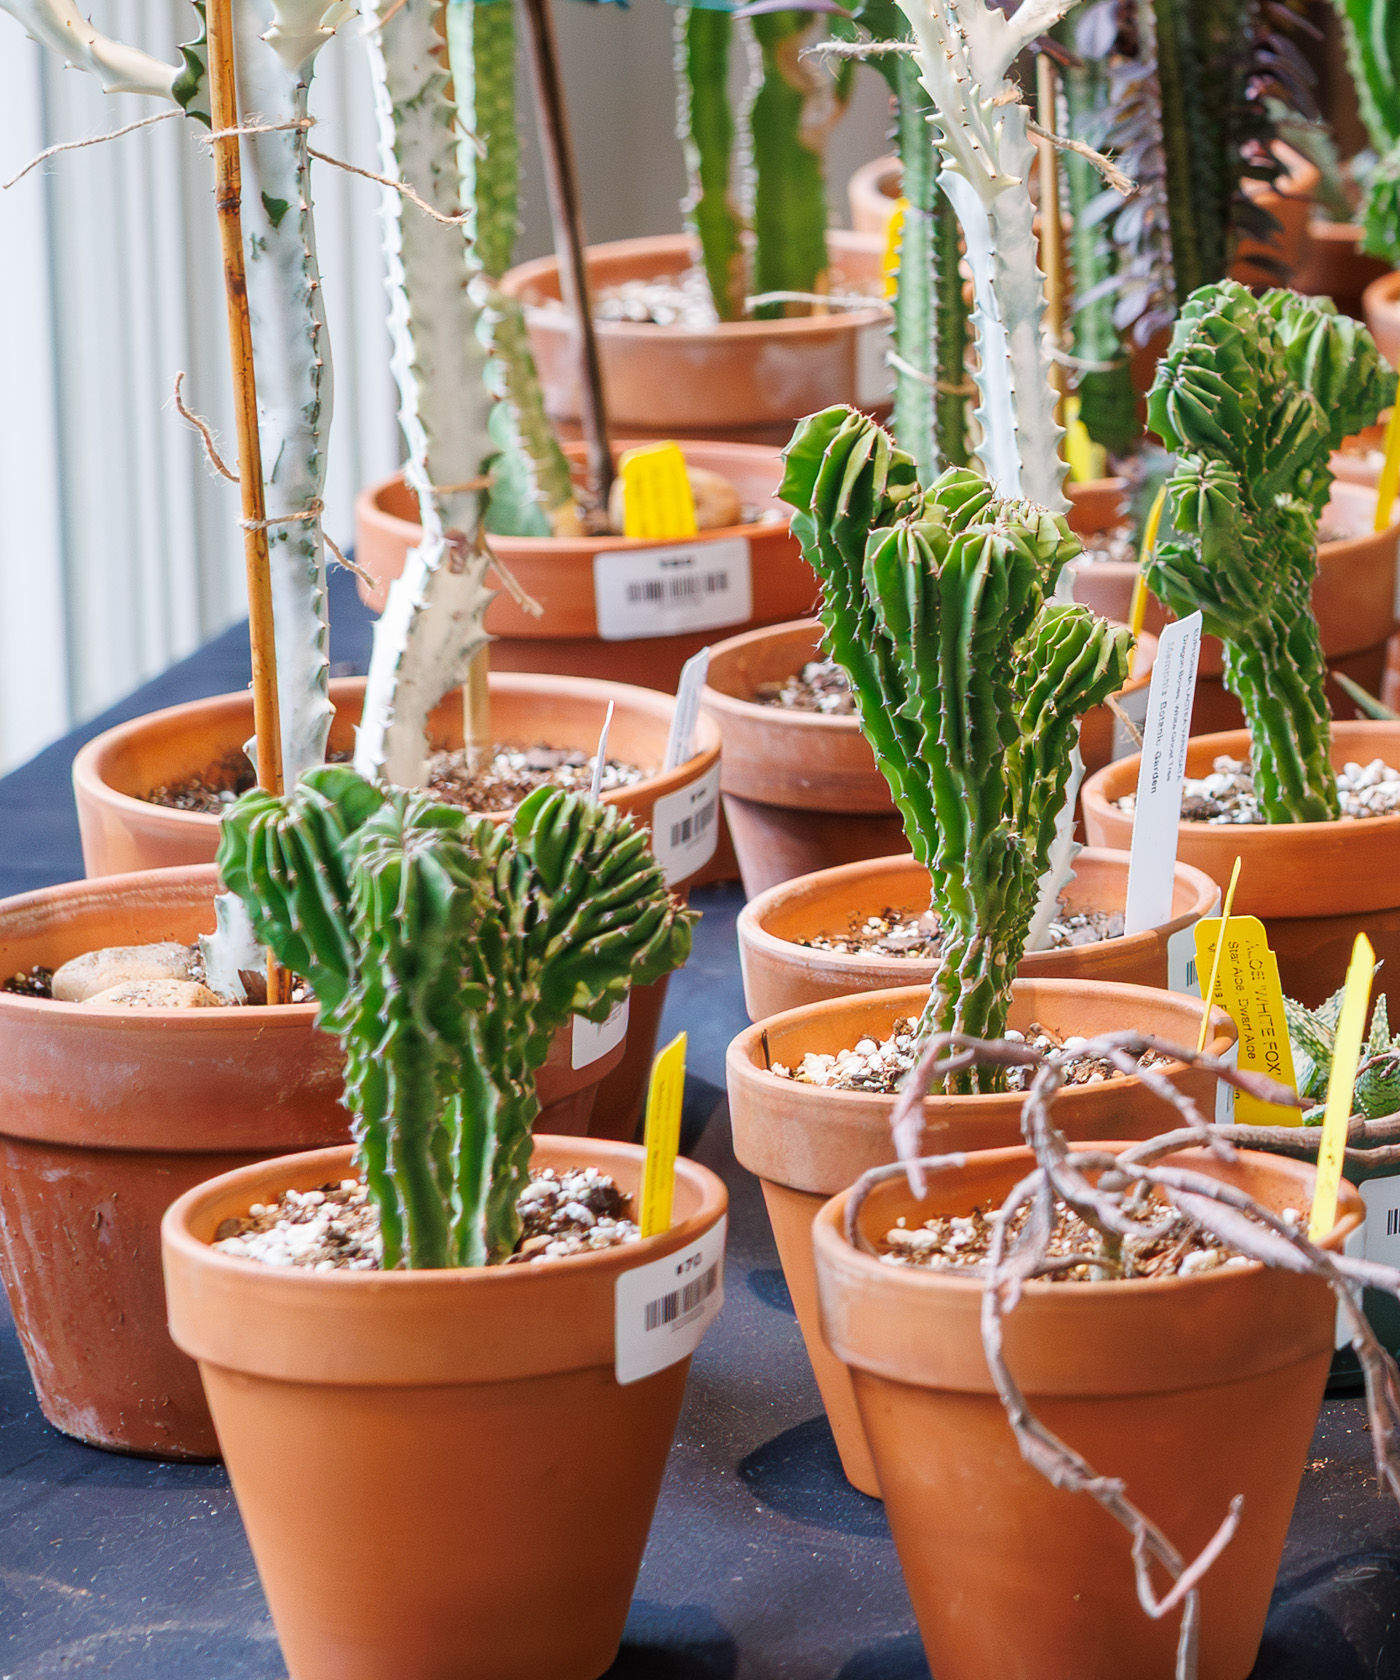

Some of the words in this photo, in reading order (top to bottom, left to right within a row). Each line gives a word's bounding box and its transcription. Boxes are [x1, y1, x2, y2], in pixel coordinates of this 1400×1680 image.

[1151, 751, 1162, 794] Garden
[1228, 941, 1239, 964] Star
[1238, 998, 1254, 1033] Dwarf
[1244, 1036, 1256, 1060] Aloe
